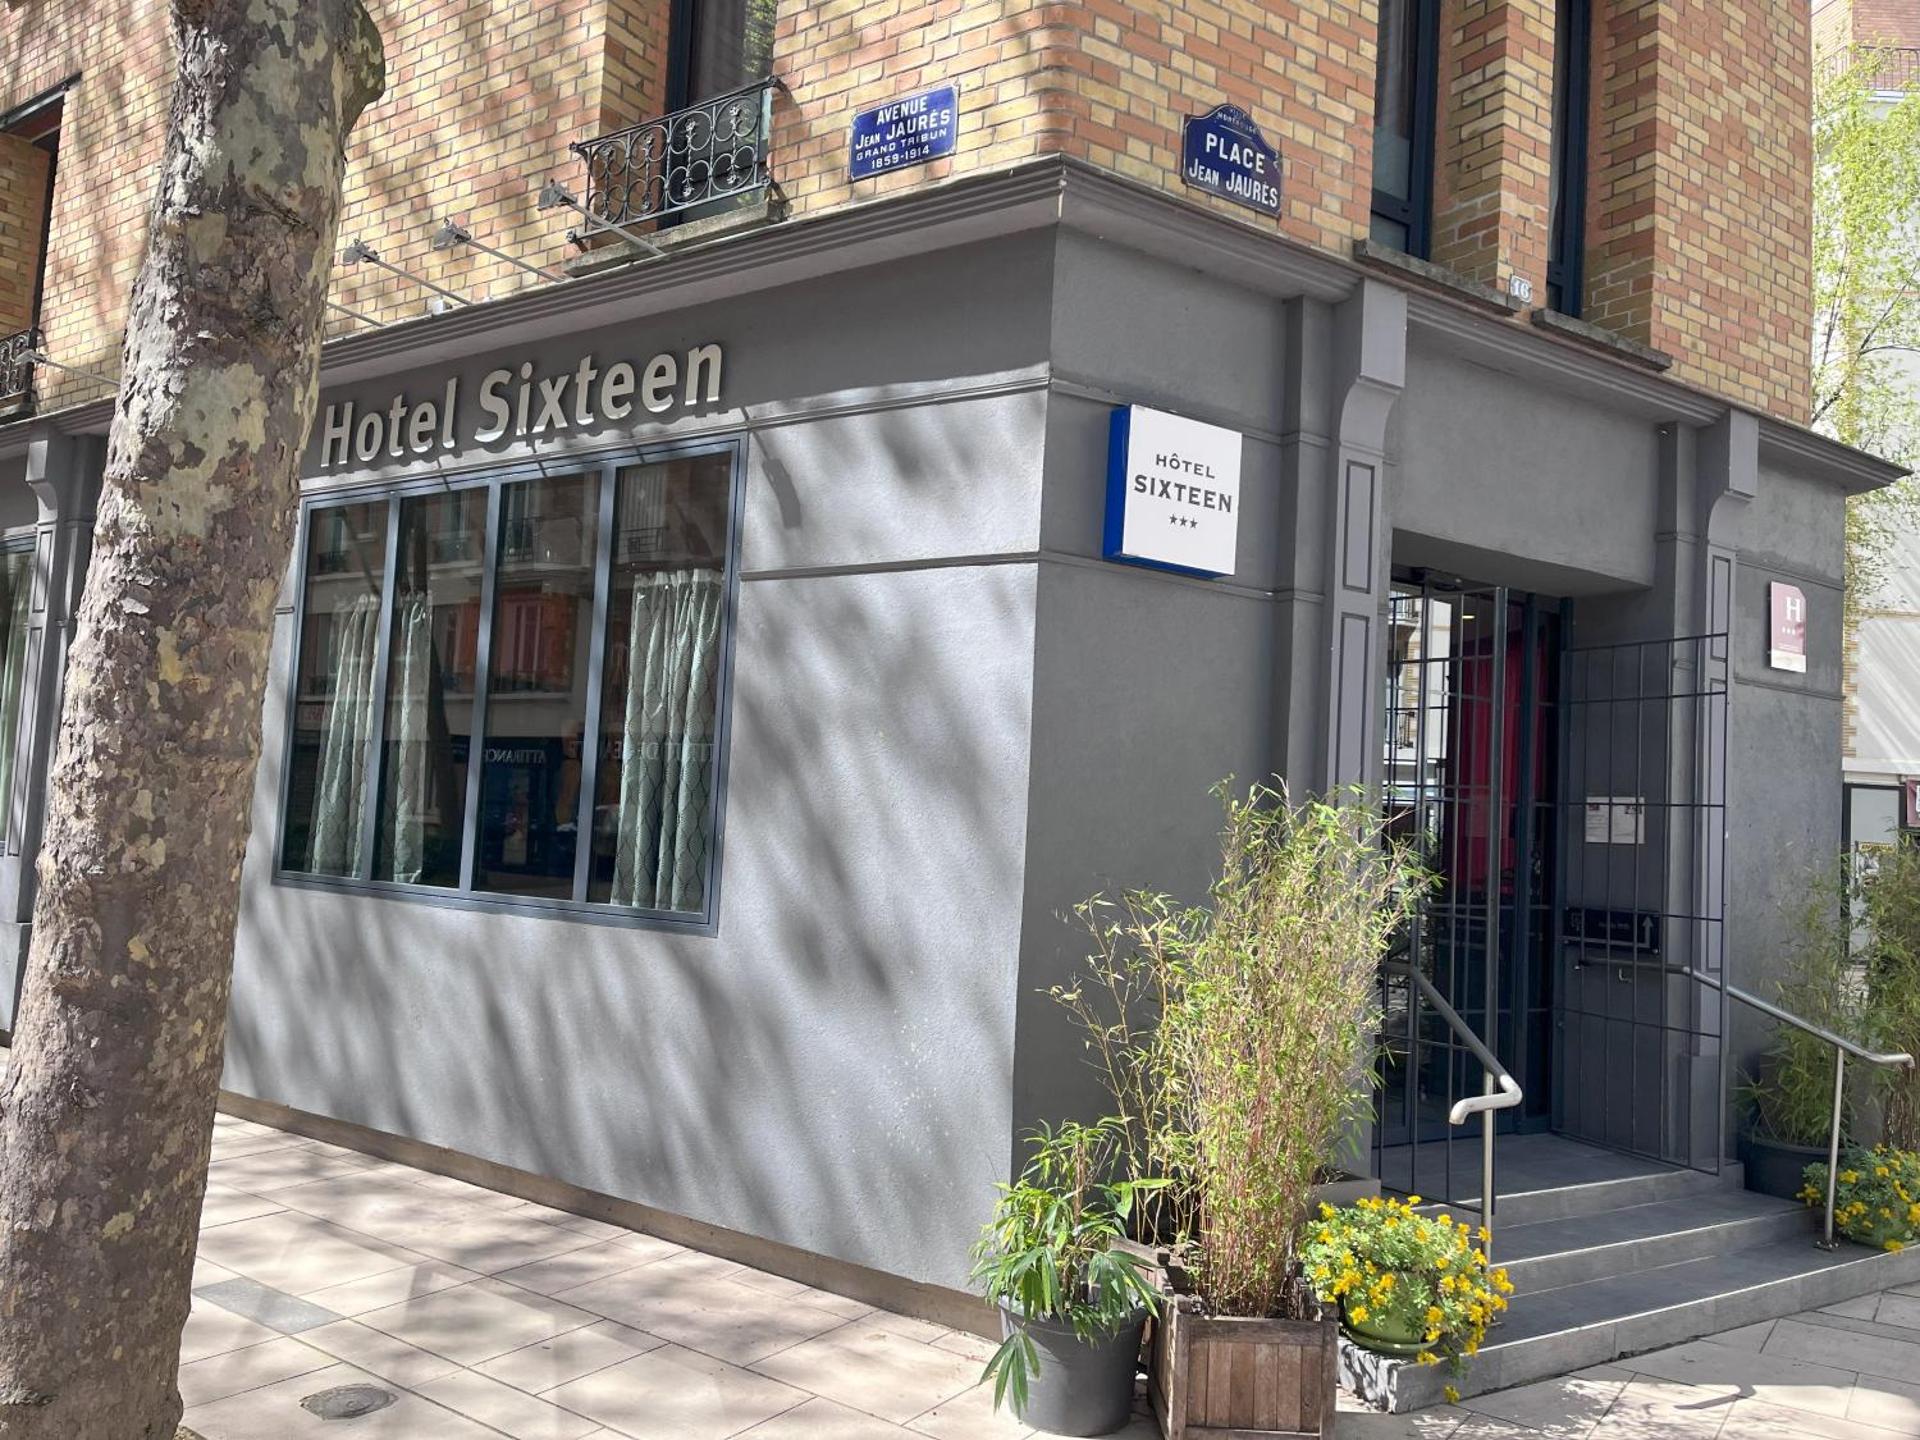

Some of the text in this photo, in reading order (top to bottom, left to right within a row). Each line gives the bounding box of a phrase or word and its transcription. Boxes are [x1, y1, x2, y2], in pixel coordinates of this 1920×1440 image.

[877, 96, 928, 126] AVENUE
[856, 132, 881, 150] JEAN
[856, 128, 948, 161] GRAND TRIBUN
[1205, 132, 1266, 175] PLACE
[872, 145, 930, 169] 1859-1914
[1189, 158, 1220, 186] JEAN
[1514, 279, 1530, 299] 16
[319, 342, 723, 469] Hotel Sixteen
[1155, 452, 1216, 479] HÔTEL
[1134, 474, 1232, 513] SIXTEEN
[1786, 596, 1802, 623] H
